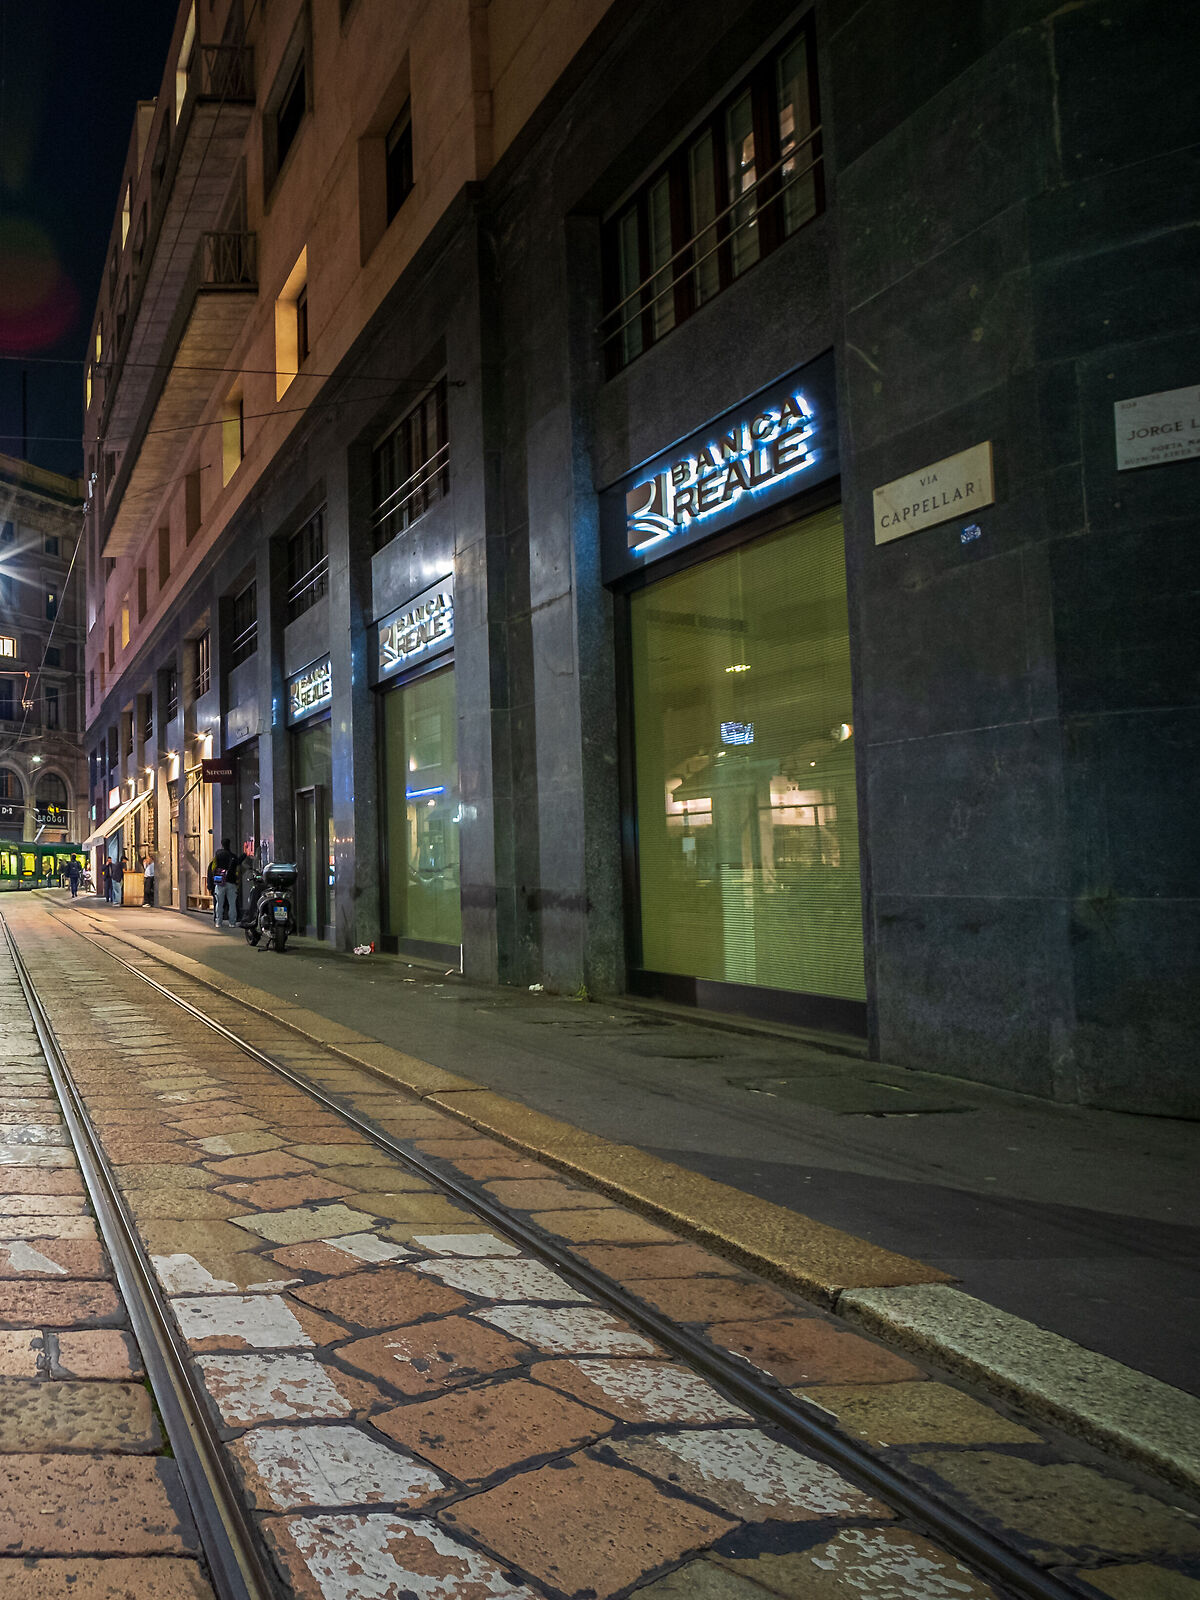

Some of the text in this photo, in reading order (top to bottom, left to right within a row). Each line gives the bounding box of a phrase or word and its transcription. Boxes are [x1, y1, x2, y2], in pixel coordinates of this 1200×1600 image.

[671, 395, 812, 487] BANCA
[1127, 421, 1184, 441] JORGE
[673, 427, 814, 526] REALE
[920, 474, 938, 487] VIA
[397, 593, 448, 633] BANCA
[398, 612, 449, 657] REALE
[37, 814, 65, 824] BROGGI
